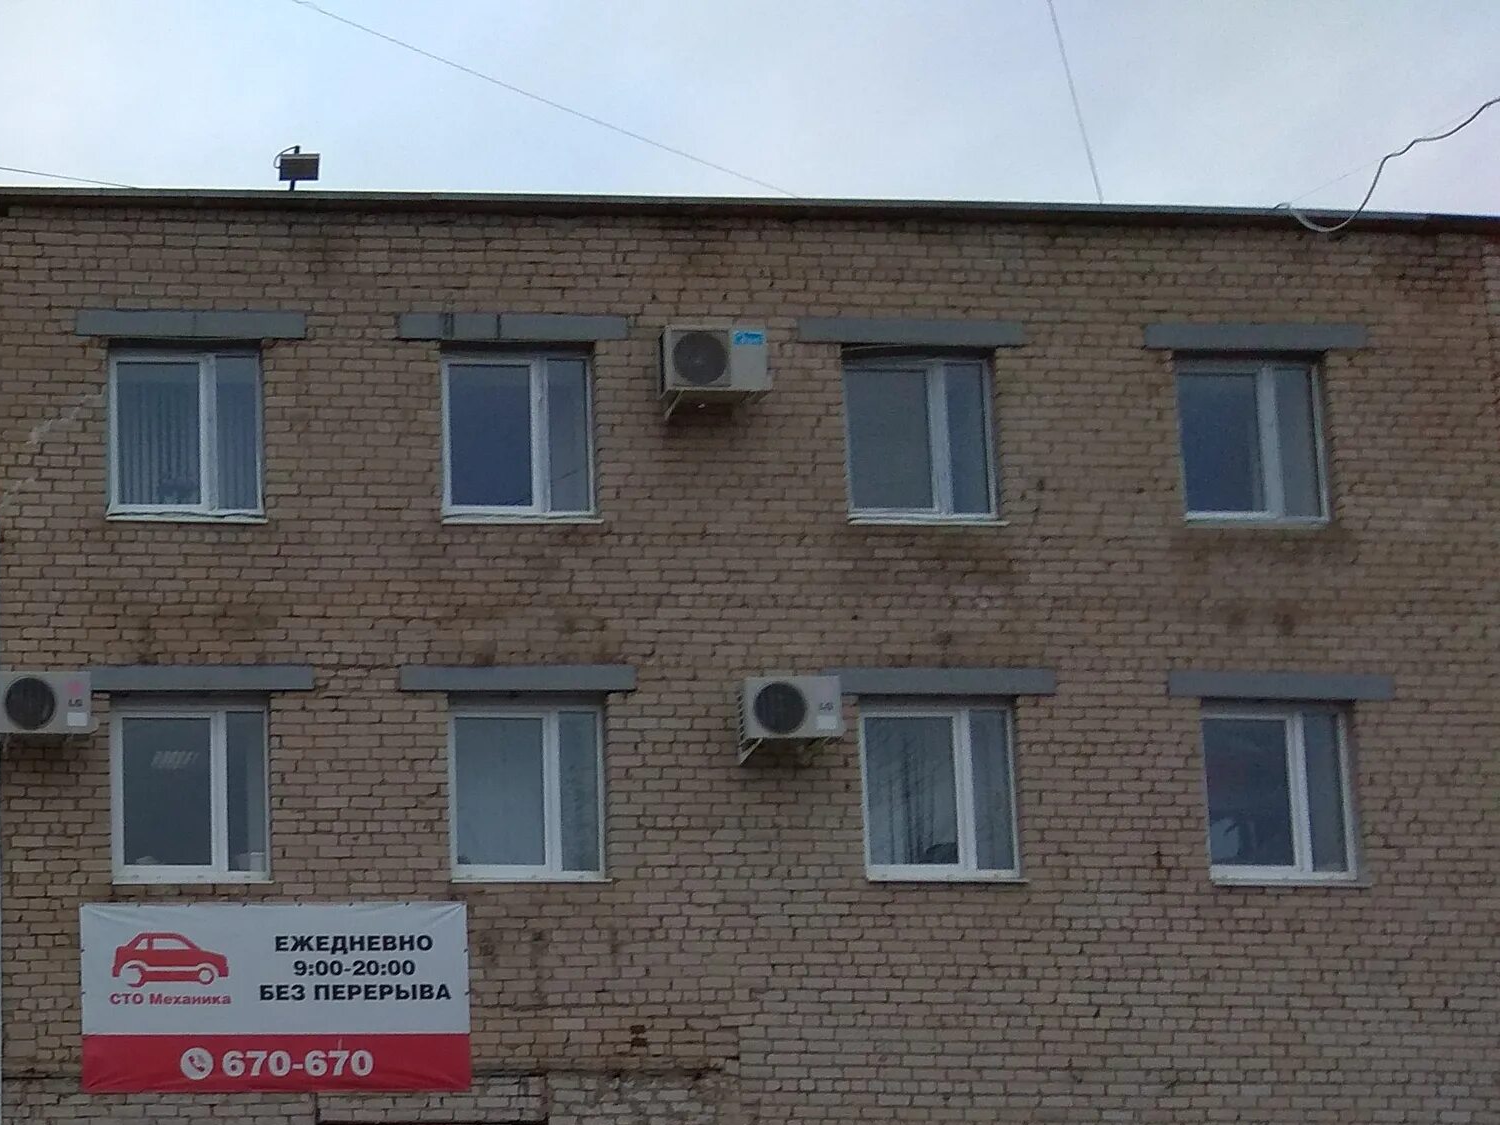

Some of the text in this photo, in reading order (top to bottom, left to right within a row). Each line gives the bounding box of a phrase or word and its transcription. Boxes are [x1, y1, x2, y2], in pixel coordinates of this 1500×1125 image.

[274, 934, 434, 955] ЕЖЕДНЕВНО
[293, 959, 416, 977] 9:00-20:00
[109, 993, 232, 1006] СТО Механика
[259, 984, 452, 1001] БЕЗ ПЕРЕРЫВА
[221, 1049, 374, 1078] 670-670
